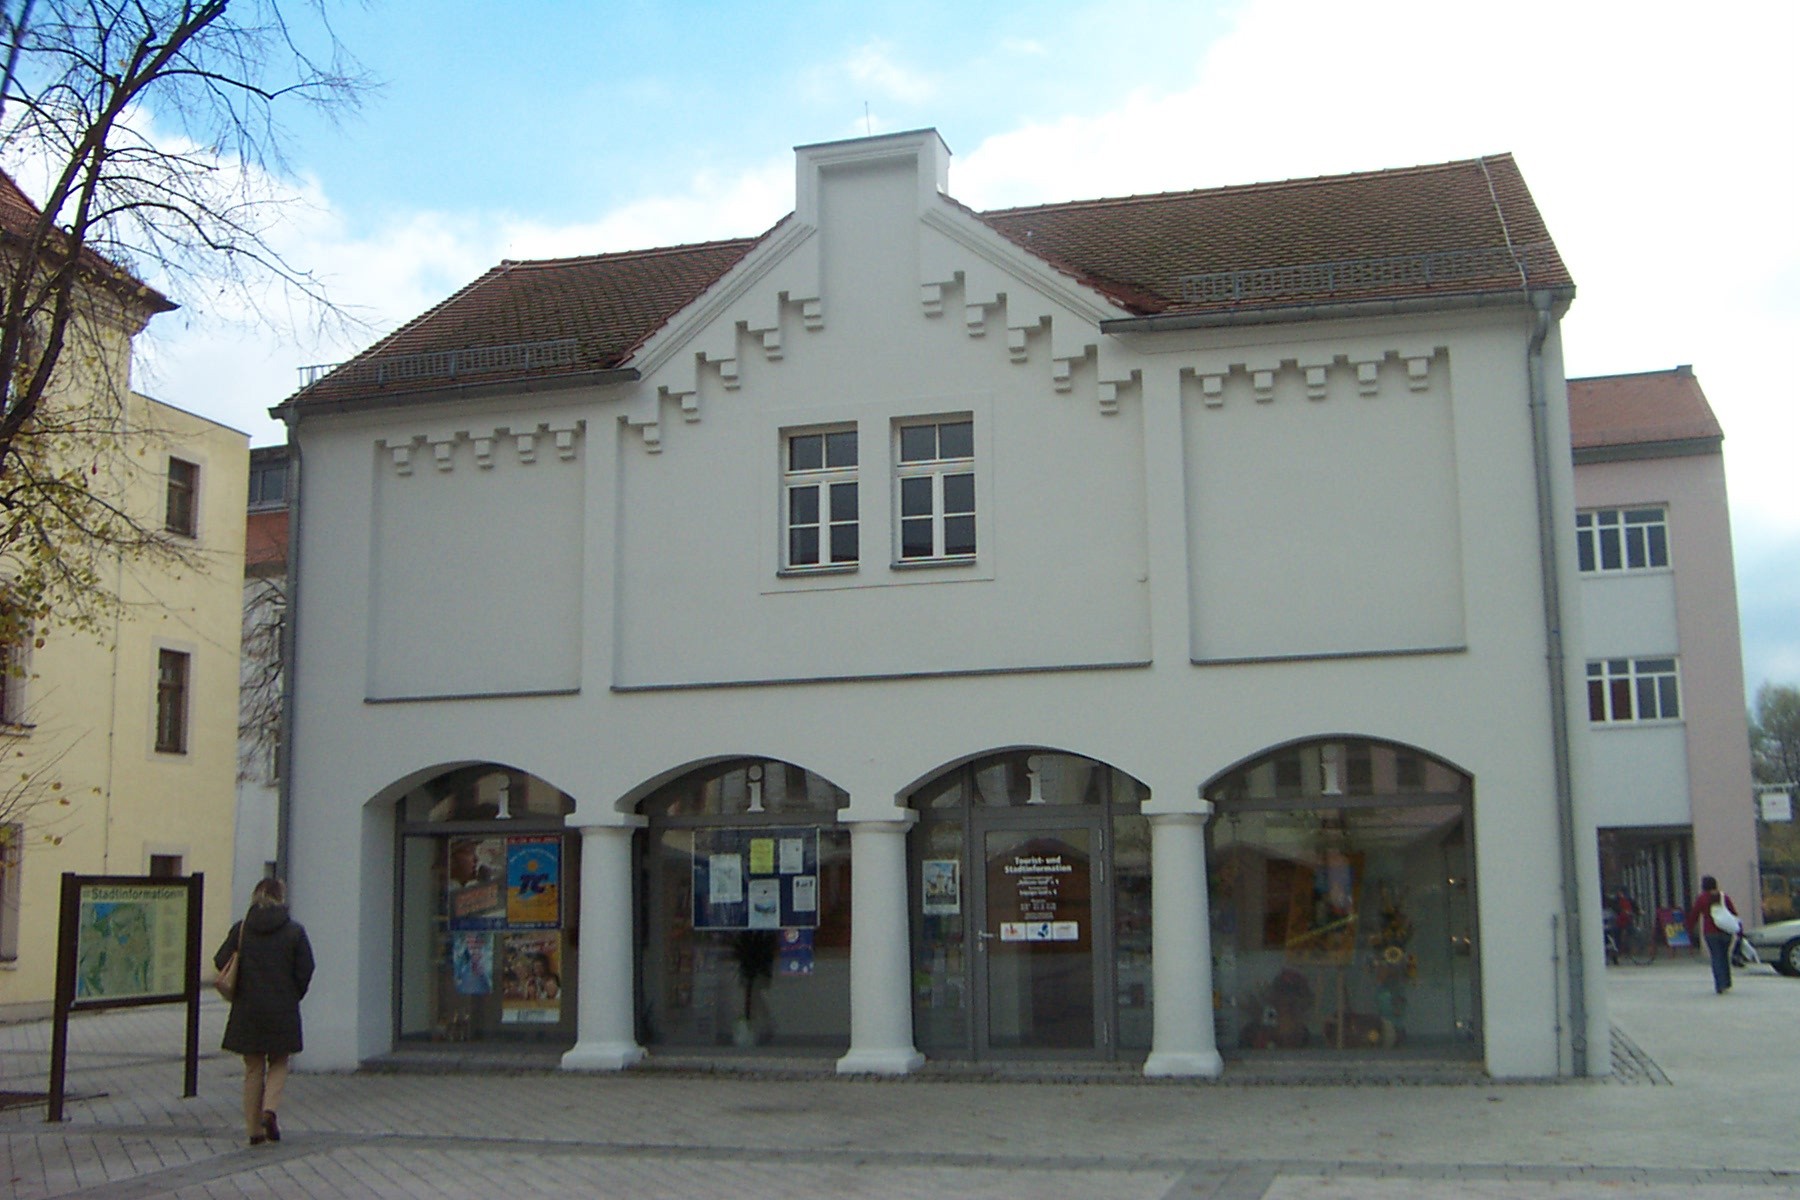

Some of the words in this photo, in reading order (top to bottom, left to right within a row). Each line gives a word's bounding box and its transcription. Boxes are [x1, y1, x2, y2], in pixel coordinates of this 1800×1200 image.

[1014, 856, 1044, 865] Tourist-
[1046, 855, 1061, 865] und
[1004, 864, 1072, 874] Stadtinformation
[91, 887, 176, 900] Stadtinformation
